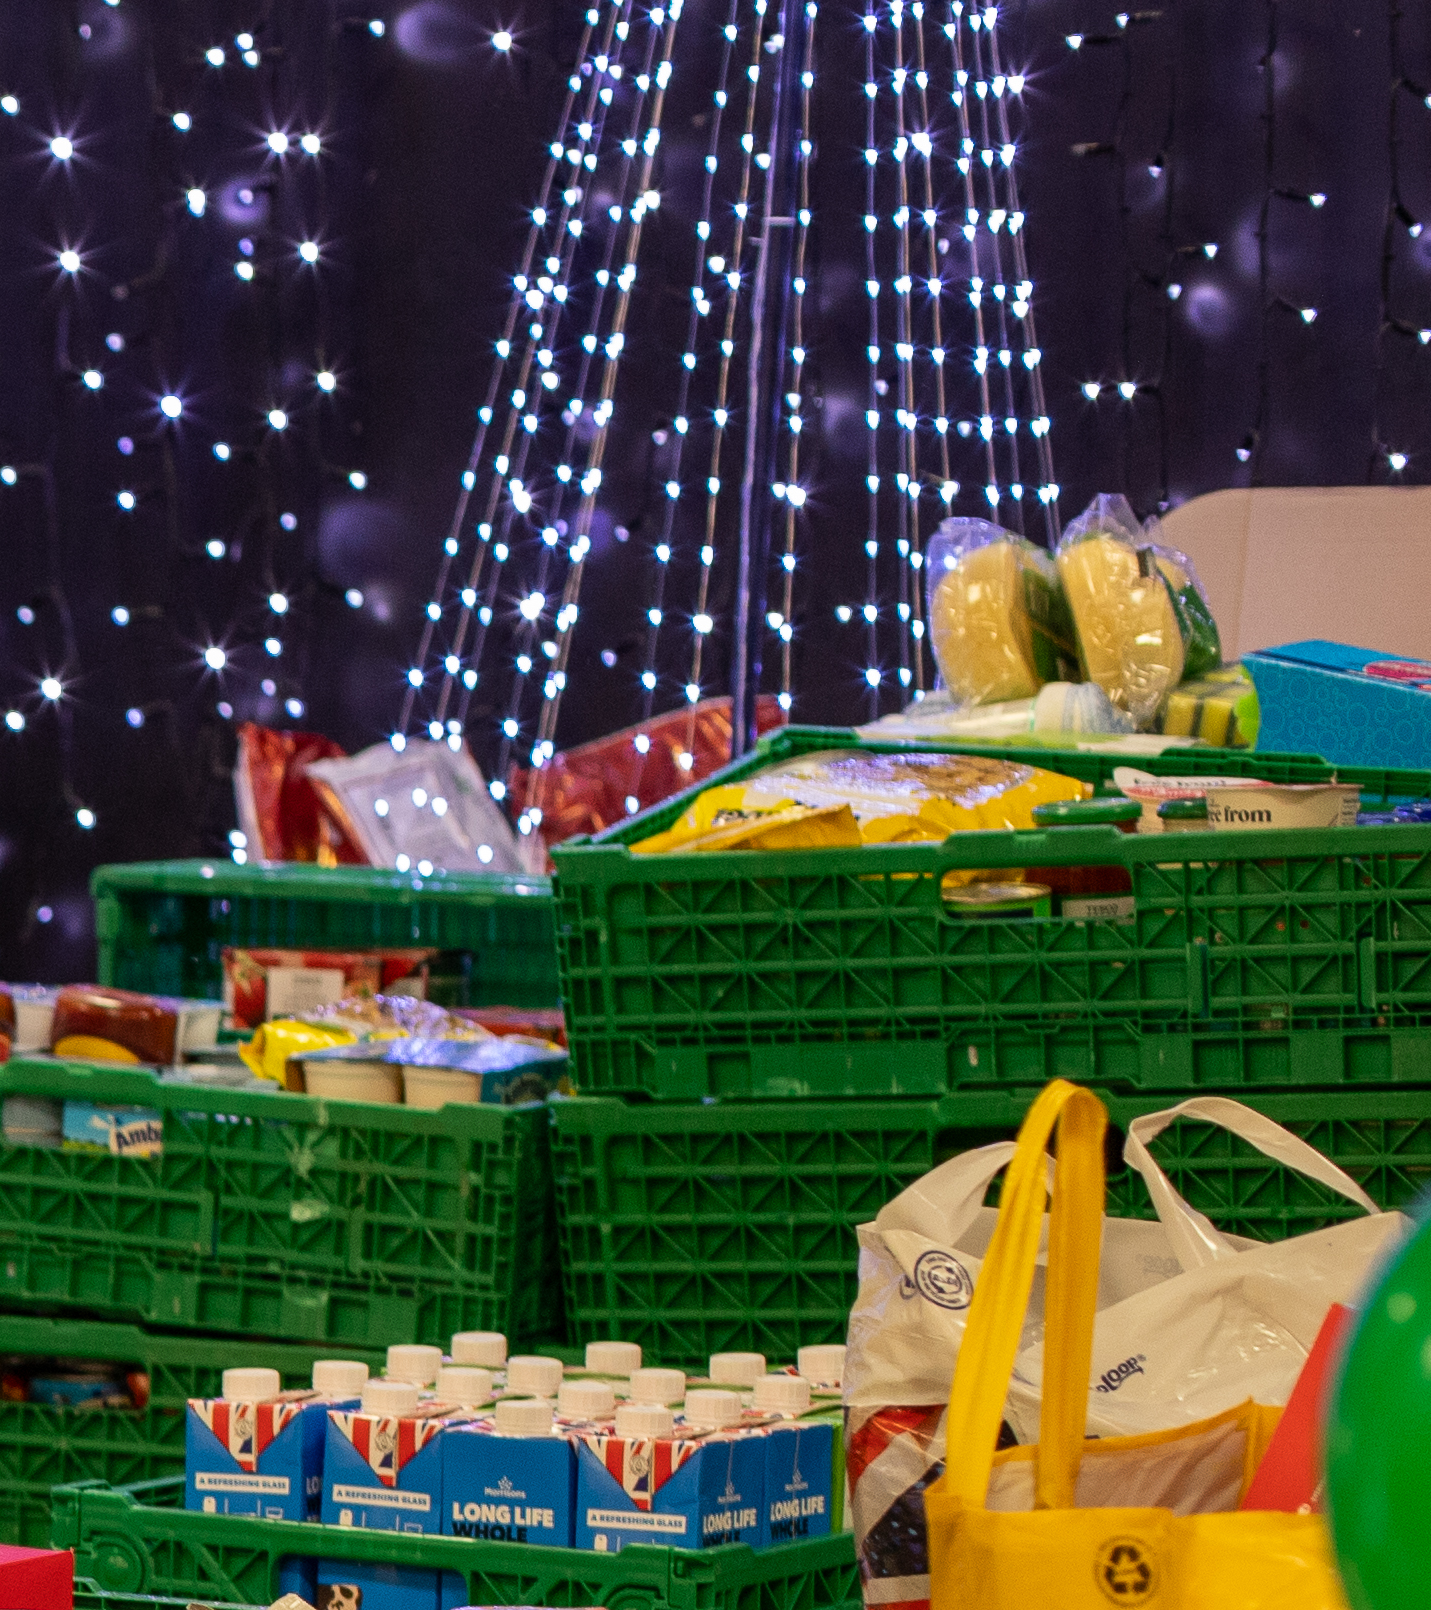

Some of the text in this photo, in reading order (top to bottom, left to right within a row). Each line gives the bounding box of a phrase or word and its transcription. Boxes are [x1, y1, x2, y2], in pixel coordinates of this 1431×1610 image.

[1224, 807, 1273, 824] from
[208, 1477, 260, 1489] REFRESHING
[262, 1479, 287, 1490] GLASS
[345, 1490, 399, 1503] REFRESHING
[401, 1495, 428, 1507] GLASS
[484, 1486, 527, 1500] Morrisons
[452, 1501, 555, 1529] LONG LIFE
[770, 1495, 825, 1522] LONG LIFE
[600, 1514, 655, 1527] REFRESHING
[657, 1517, 683, 1529] GLASS
[703, 1508, 757, 1534] LONG LIFE
[451, 1522, 529, 1543] WHOLE
